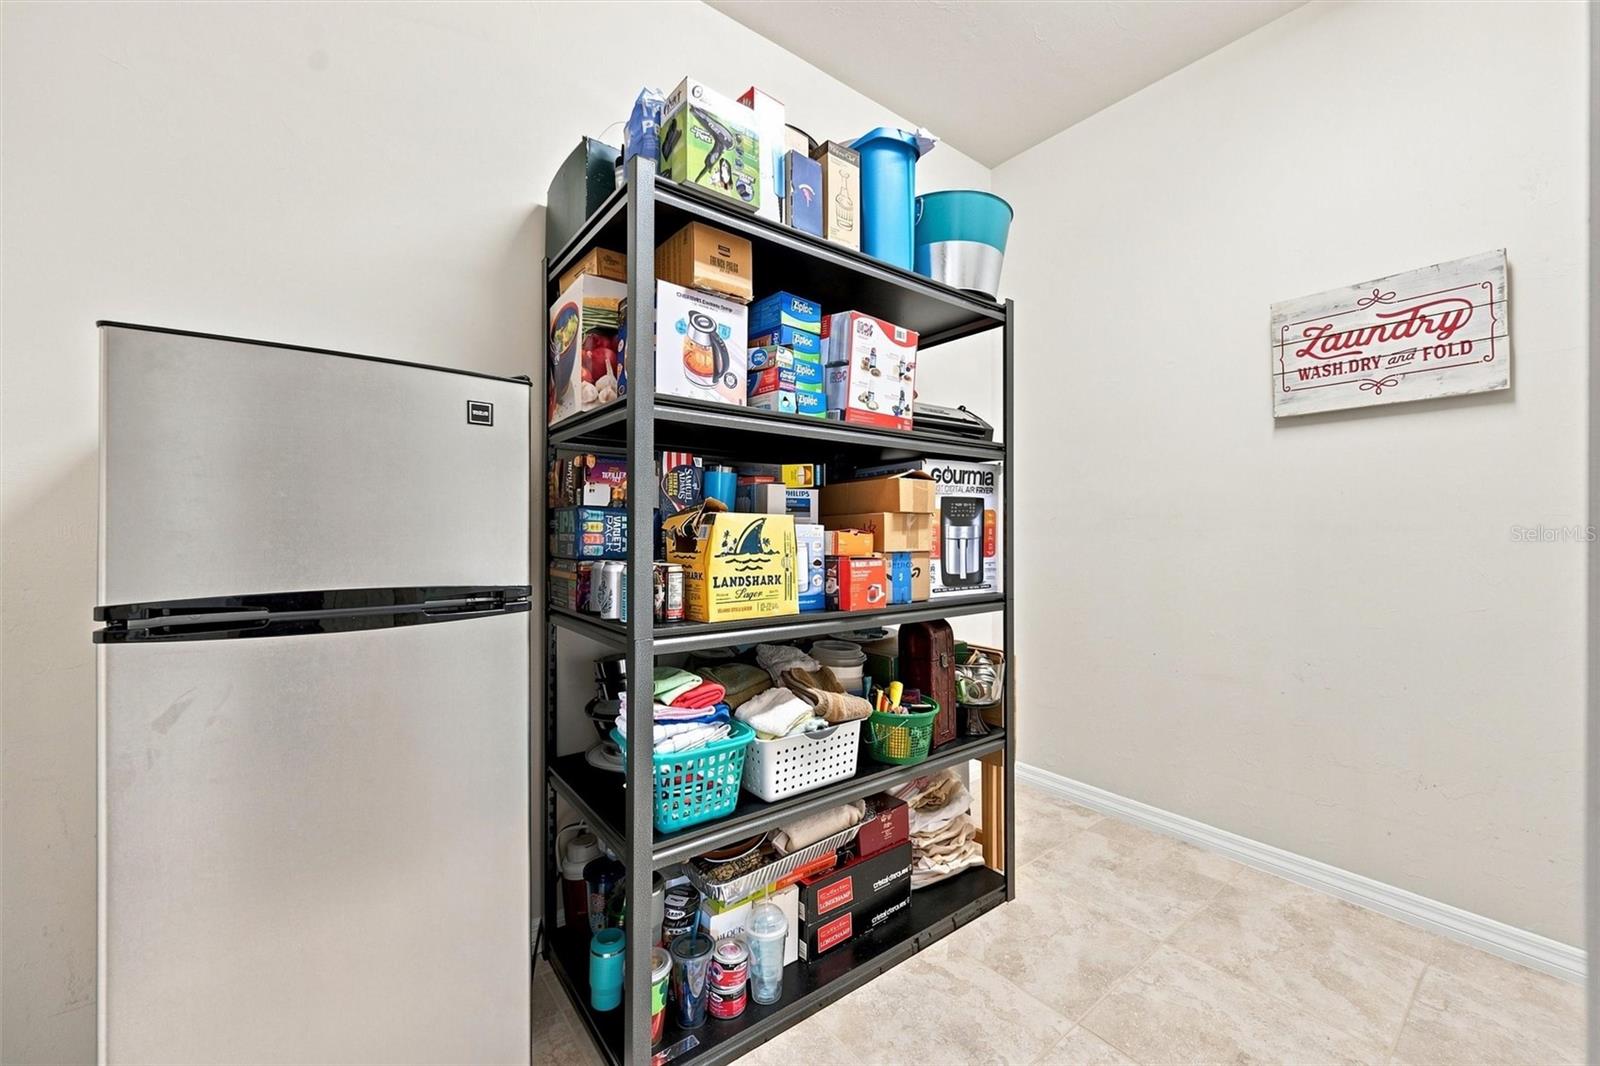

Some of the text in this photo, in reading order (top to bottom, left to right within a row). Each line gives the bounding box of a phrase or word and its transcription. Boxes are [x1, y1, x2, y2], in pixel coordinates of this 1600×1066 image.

[793, 300, 813, 315] Ziploc
[1296, 298, 1473, 360] Laundry
[793, 333, 813, 347] Ziploc
[1387, 347, 1418, 365] and
[1423, 340, 1473, 361] FOLD
[796, 364, 815, 377] Ziploc
[798, 394, 818, 406] Ziploc
[677, 470, 686, 499] ADAMS
[684, 468, 694, 503] SAMUEL
[965, 486, 975, 494] AIR
[976, 486, 994, 495] FRYER
[604, 515, 613, 553] PACK
[612, 516, 621, 552] VARIETY
[713, 575, 782, 588] LANDSHARK
[735, 587, 763, 600] Lager
